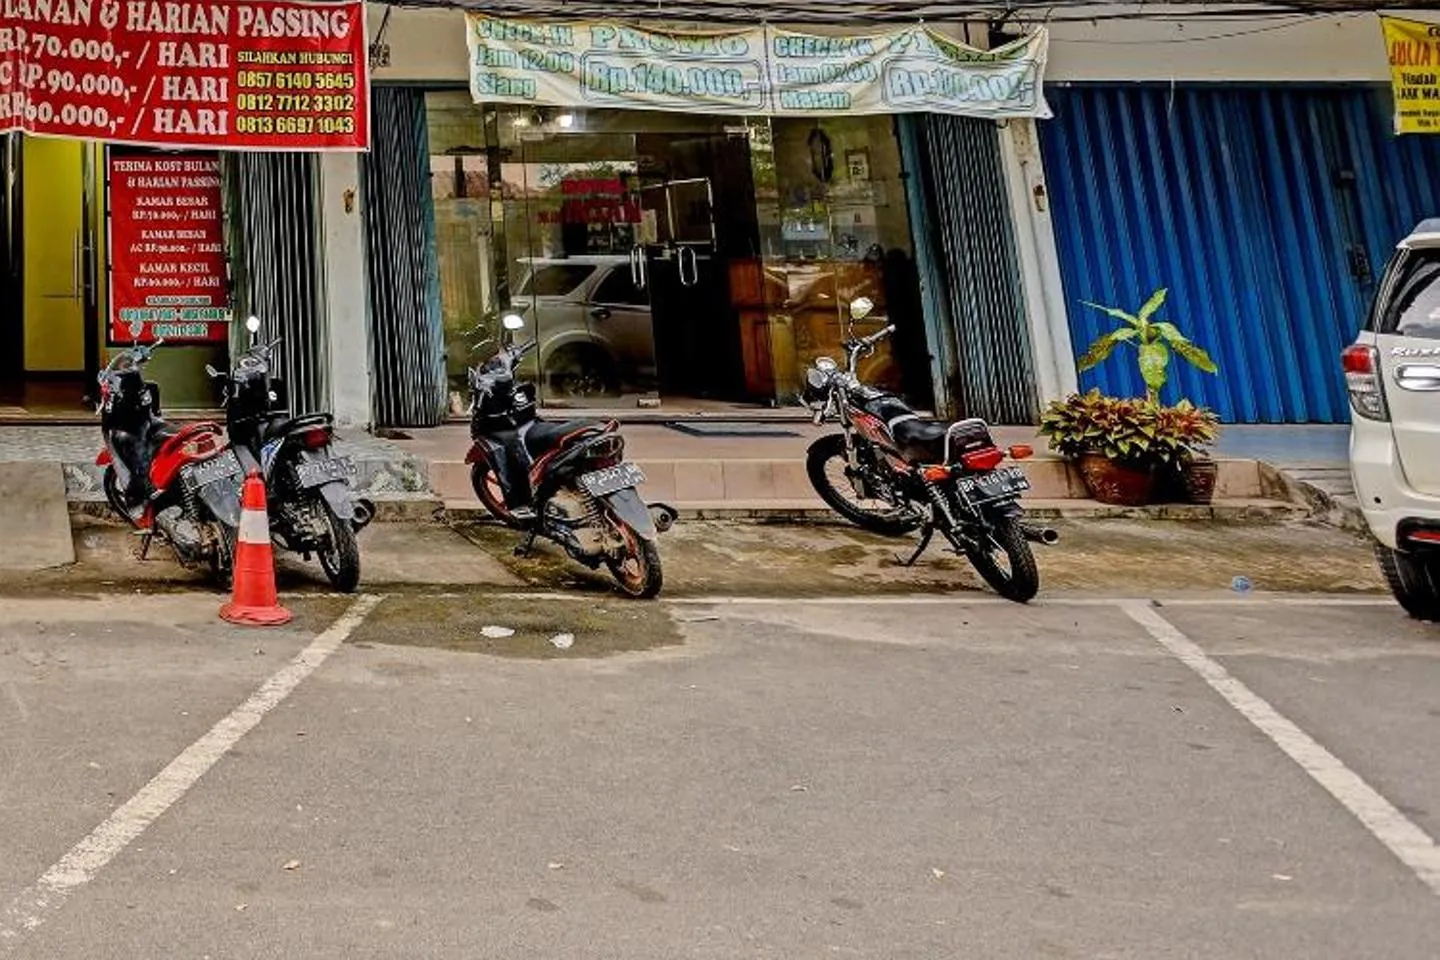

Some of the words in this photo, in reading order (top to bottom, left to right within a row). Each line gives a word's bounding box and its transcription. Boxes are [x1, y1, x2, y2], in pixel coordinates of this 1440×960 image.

[126, 1, 229, 36] HARIAN
[237, 6, 350, 38] PASSING
[136, 41, 149, 69] /
[157, 43, 228, 68] HARI
[237, 51, 297, 64] SILAHKAN
[299, 53, 353, 64] HUBUNGI
[237, 71, 273, 88] 0857
[276, 72, 312, 88] 6140
[315, 73, 354, 89] 5645
[142, 75, 156, 104] /
[162, 76, 228, 102] HARI
[237, 93, 273, 110] 0812
[277, 94, 310, 111] 7712
[314, 95, 354, 111] 3302
[780, 89, 852, 110] Malam
[131, 108, 144, 135] /
[153, 107, 228, 135] HARI
[237, 116, 273, 133] 0813
[276, 117, 313, 133] 6697
[316, 117, 354, 133] 1043
[113, 161, 152, 172] TERIMA
[155, 161, 183, 172] KOST
[136, 196, 173, 206] KAMAR
[140, 263, 177, 273] KAMAR
[180, 263, 210, 273] KECIL
